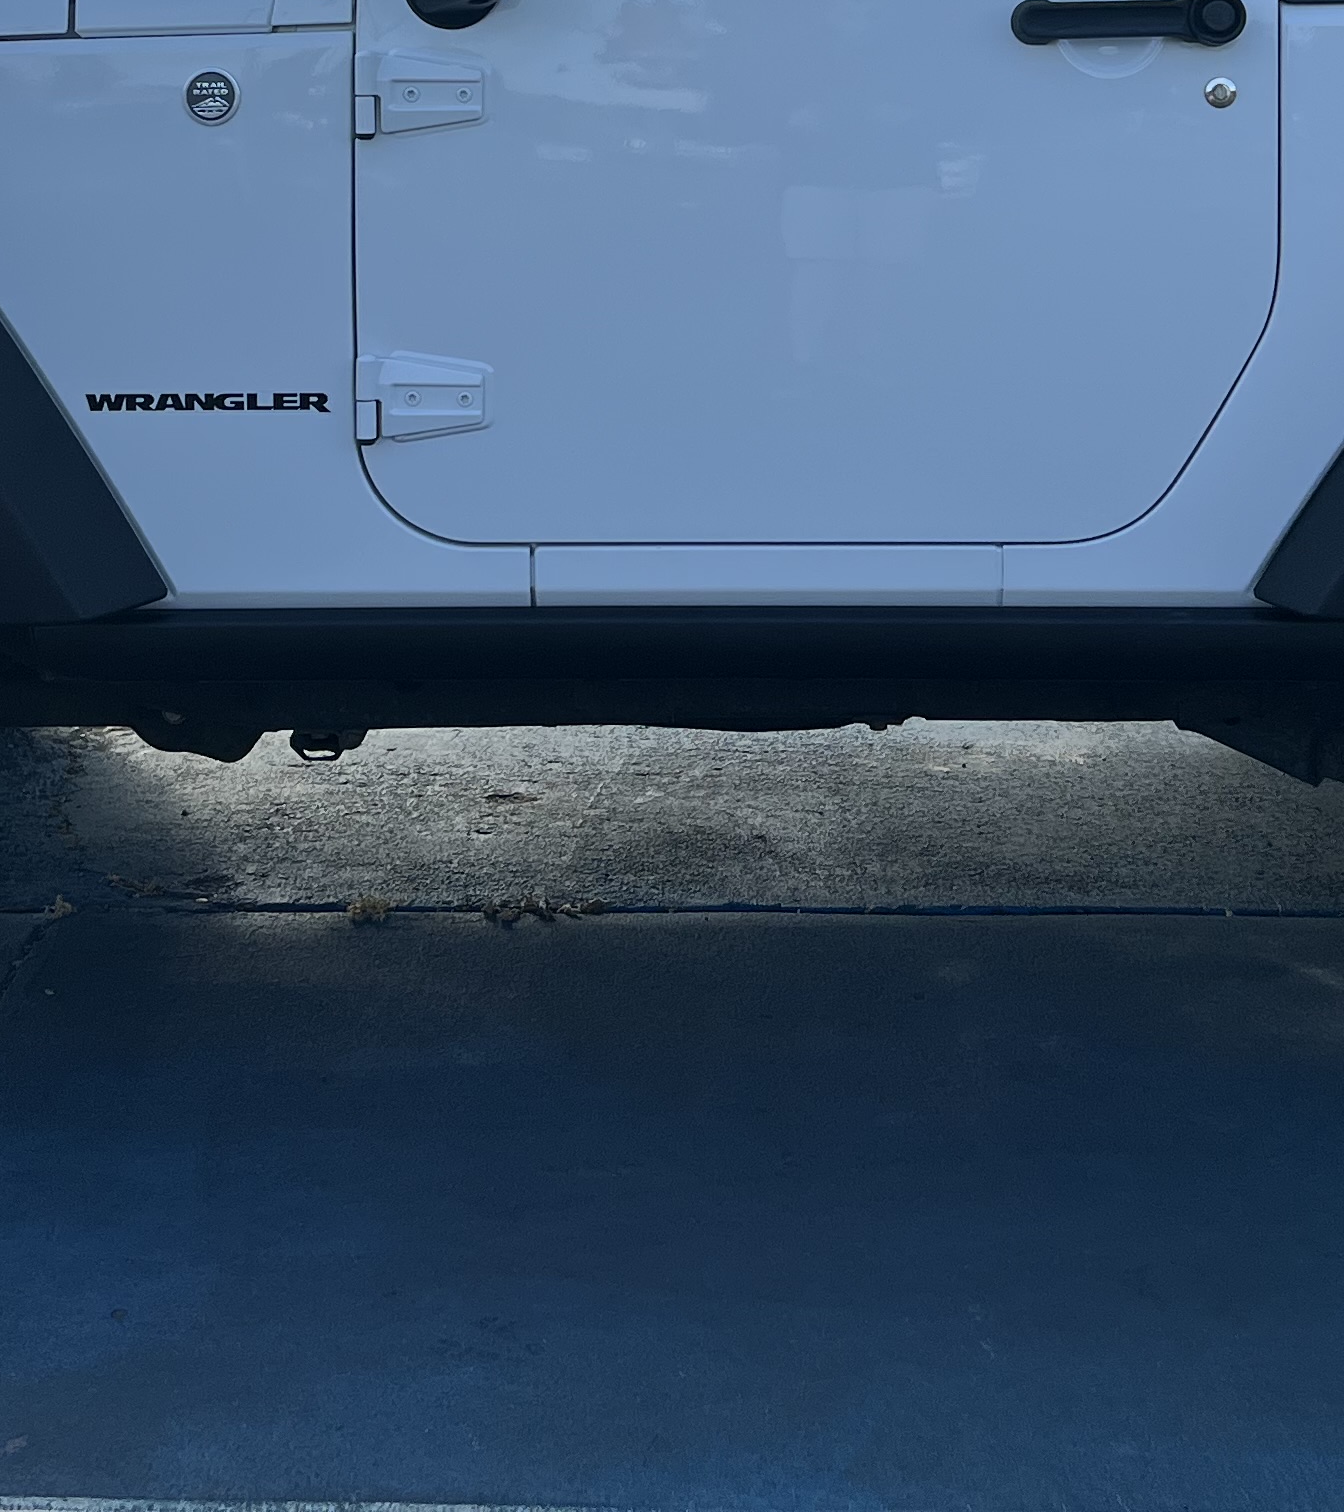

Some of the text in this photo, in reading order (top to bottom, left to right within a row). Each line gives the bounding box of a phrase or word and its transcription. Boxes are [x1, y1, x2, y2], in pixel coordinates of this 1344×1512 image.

[196, 81, 227, 89] TRAIL
[192, 88, 229, 96] RATED
[85, 393, 331, 412] WRANGLER
